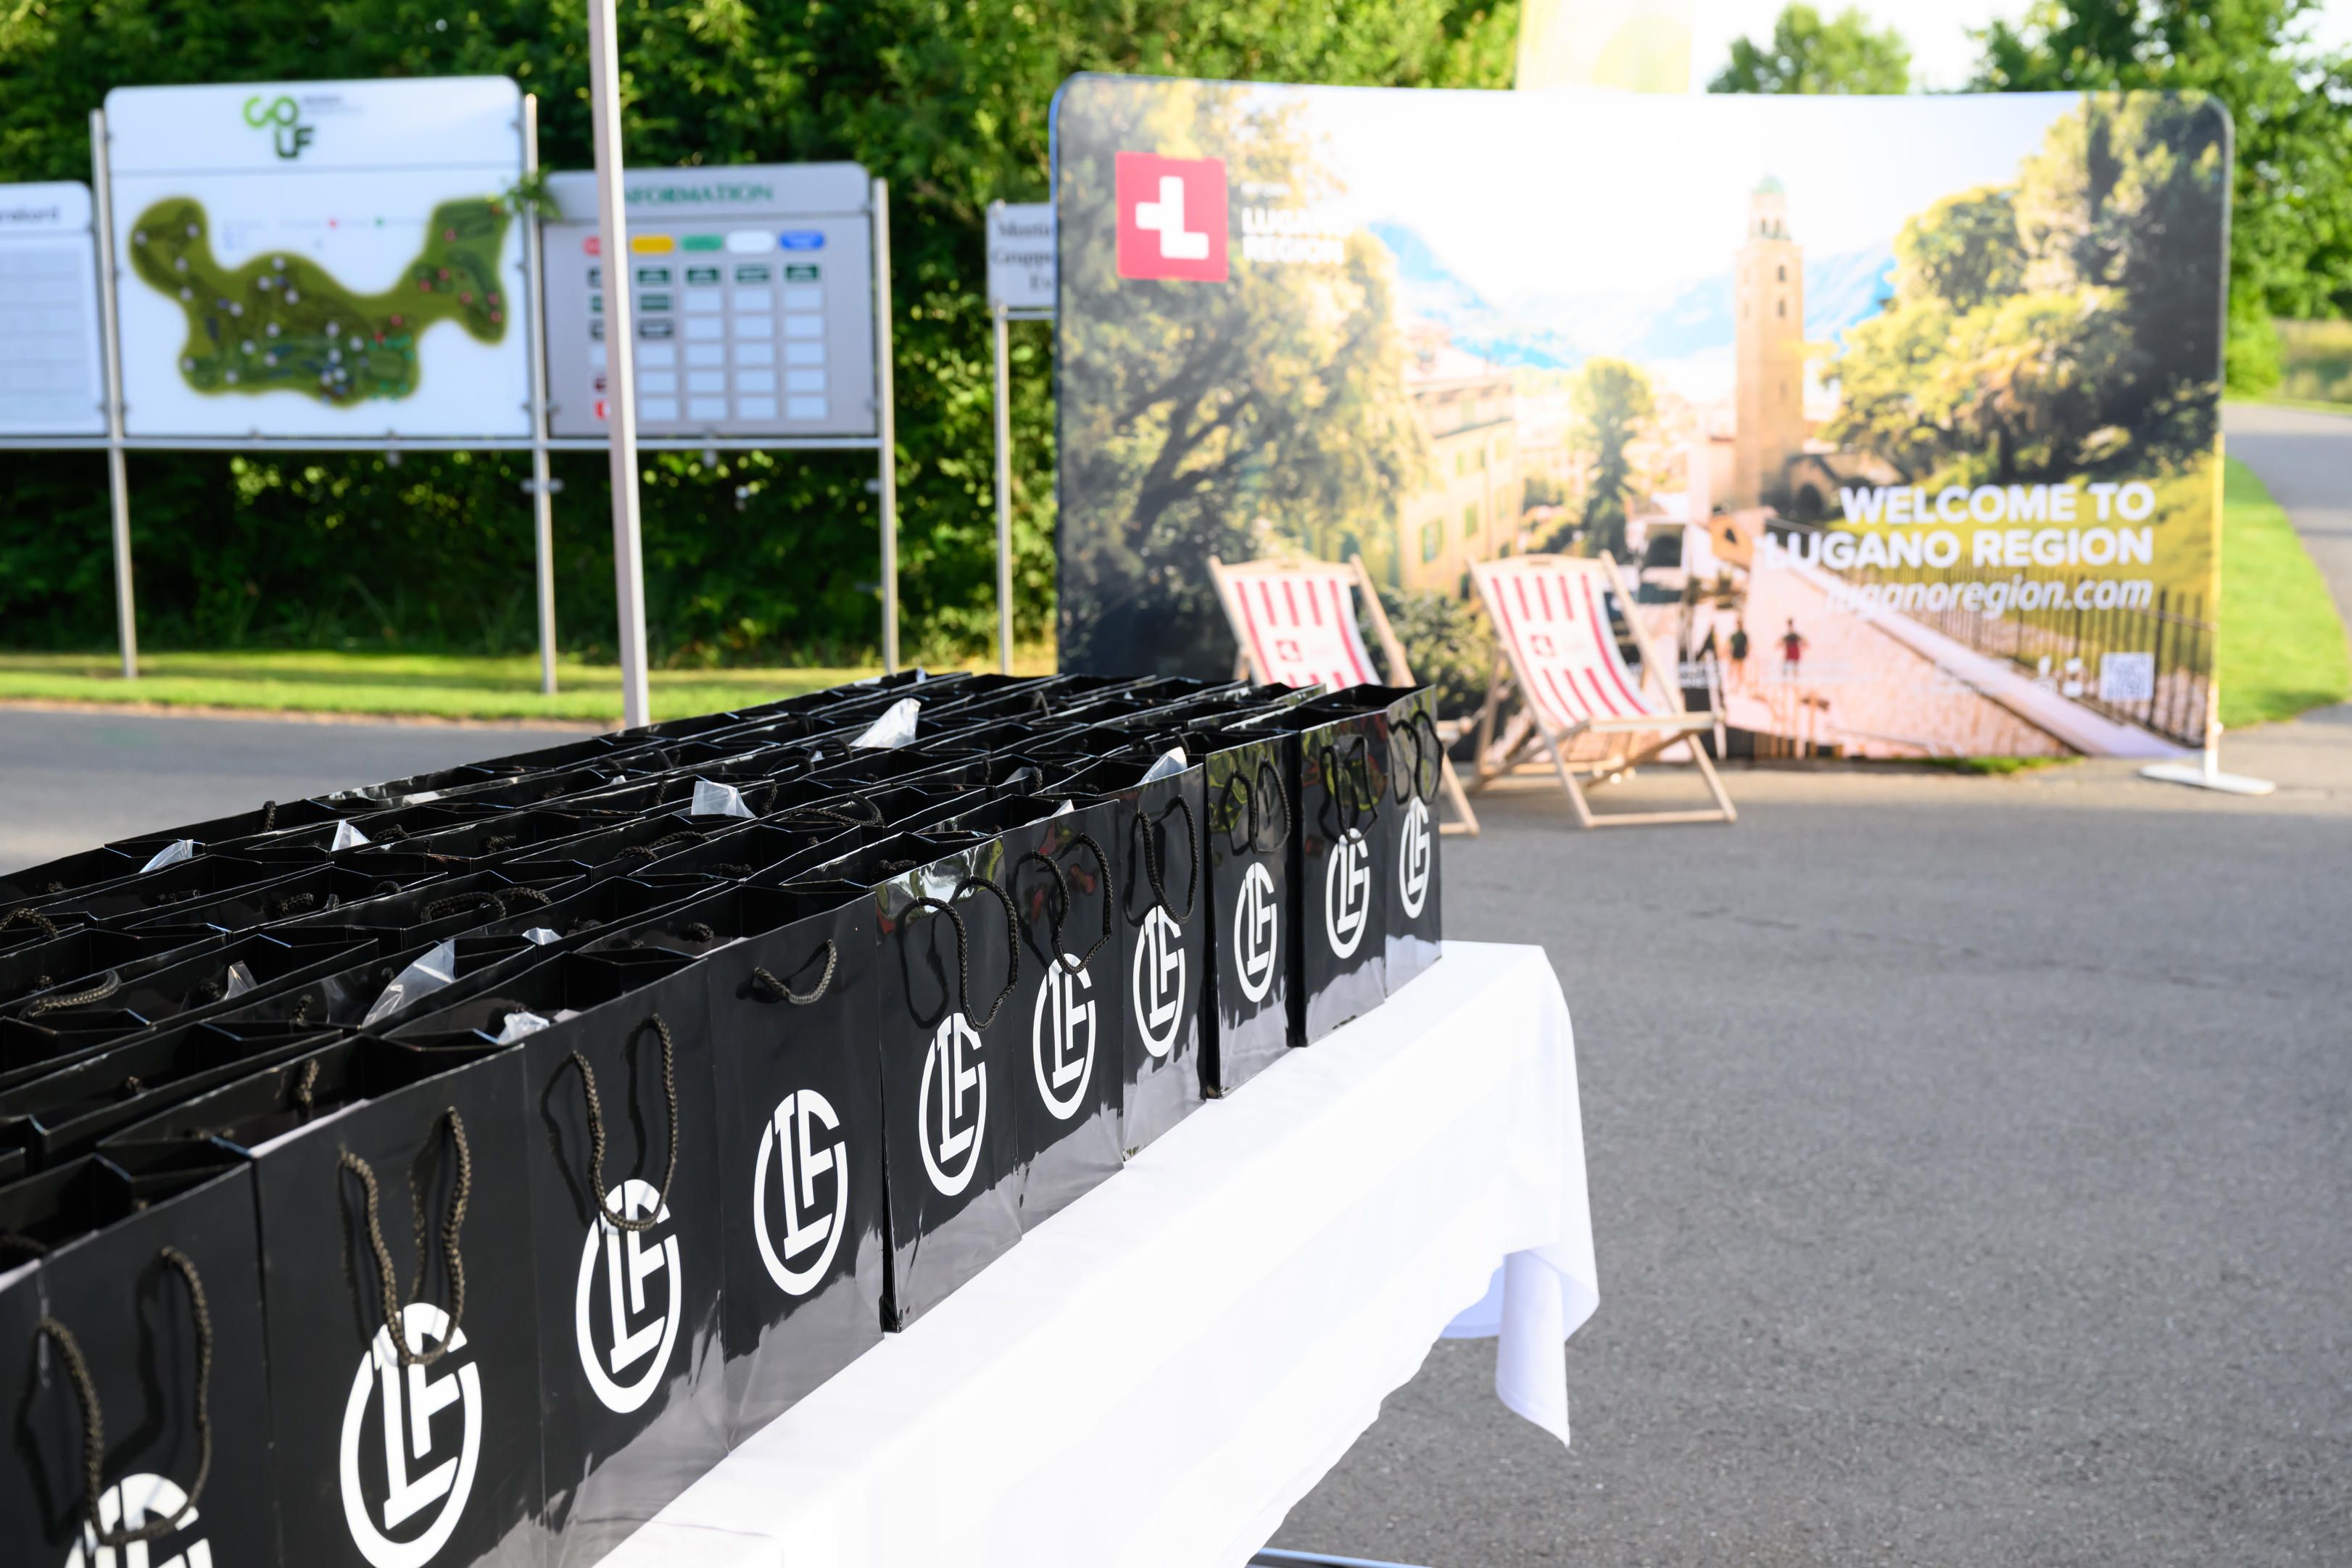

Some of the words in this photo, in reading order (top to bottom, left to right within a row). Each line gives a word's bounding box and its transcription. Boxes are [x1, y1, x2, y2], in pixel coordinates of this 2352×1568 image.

[1839, 484, 2077, 525] WELCOME
[2088, 482, 2156, 522] TO
[1764, 530, 1960, 571] LUGANO
[1974, 527, 2153, 568] REGION
